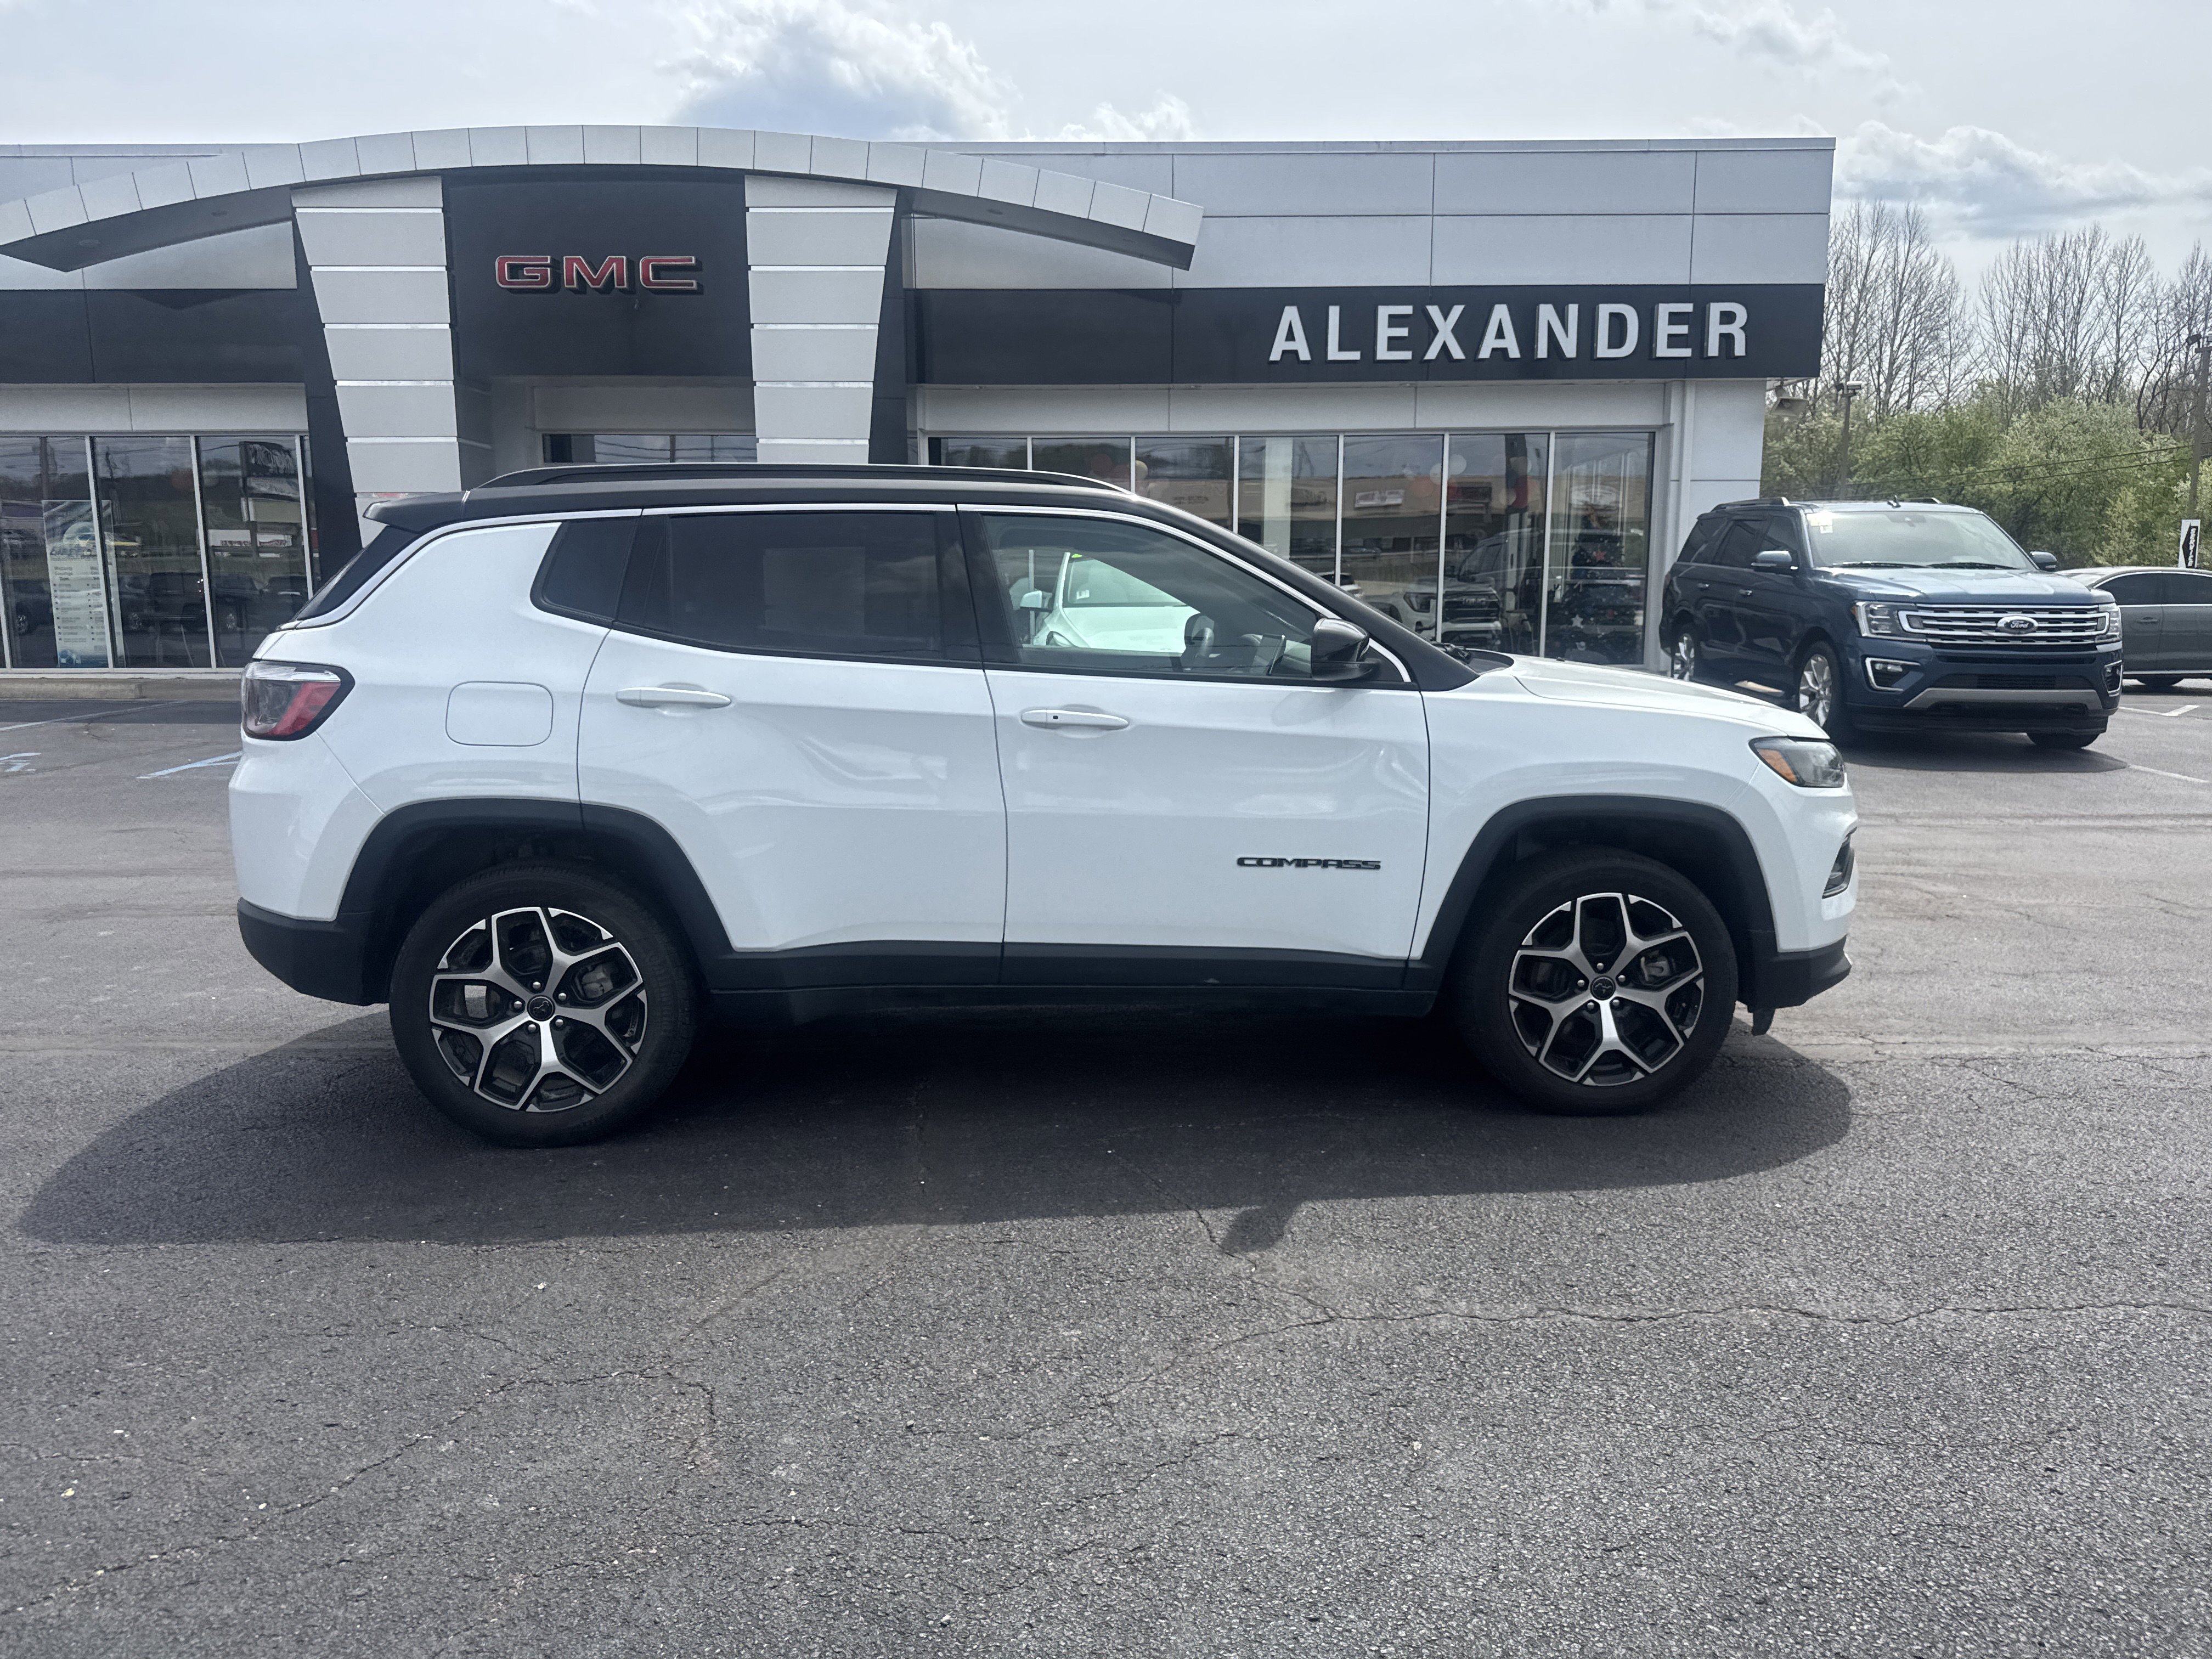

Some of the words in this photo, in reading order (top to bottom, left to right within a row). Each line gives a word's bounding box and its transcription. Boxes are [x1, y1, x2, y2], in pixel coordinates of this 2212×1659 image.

[495, 255, 697, 290] GMC
[1268, 302, 1748, 362] ALEXANDER
[2187, 528, 2196, 566] SERVICE
[1237, 857, 1381, 870] COMPASS
